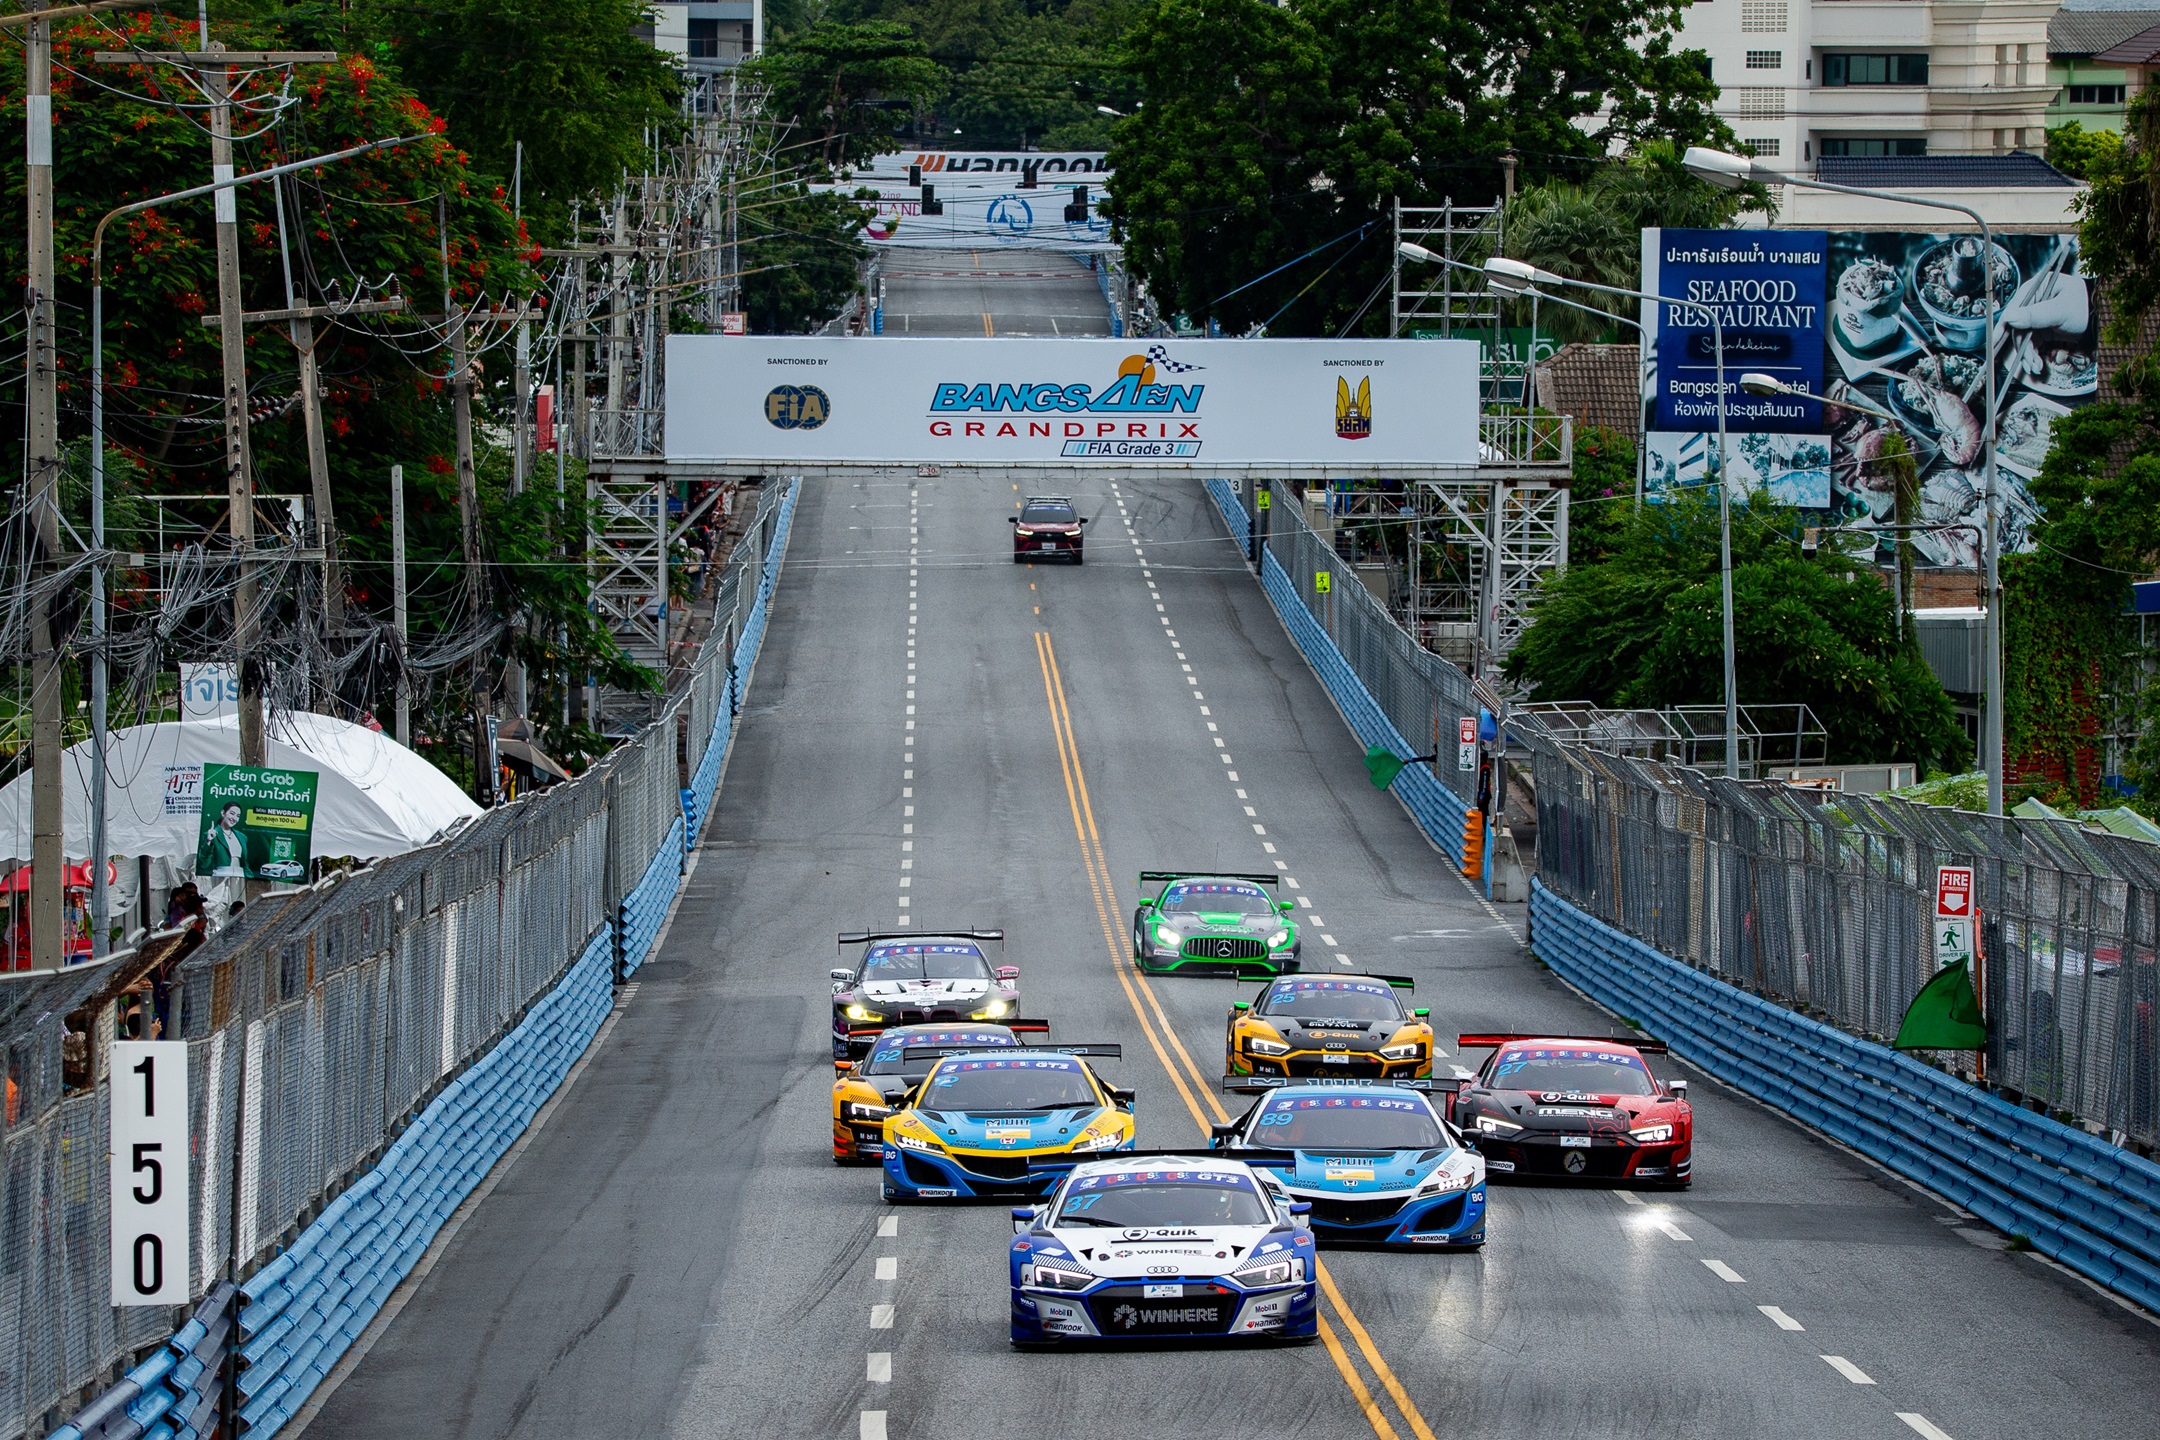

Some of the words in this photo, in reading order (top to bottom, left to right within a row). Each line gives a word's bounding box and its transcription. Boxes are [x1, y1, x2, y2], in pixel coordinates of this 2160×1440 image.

[1769, 250, 1821, 264] บางแสน
[1687, 279, 1797, 304] SEAFOOD
[1667, 304, 1816, 329] RESTAURANT
[930, 374, 1206, 413] BANGSAEN
[1669, 379, 1737, 398] Bangsaen
[1088, 442, 1112, 456] FIA
[1116, 442, 1162, 456] Grade
[1165, 442, 1175, 456] 3
[229, 769, 257, 783] เรียก
[260, 772, 296, 786] Grab
[267, 808, 301, 817] NEWGRAB
[1941, 872, 1969, 887] FIRE
[1270, 993, 1296, 1005] 25
[873, 1050, 902, 1062] 62
[1497, 1061, 1528, 1077] 27
[1259, 1112, 1295, 1127] 89
[1538, 1107, 1614, 1118] MENG
[884, 1150, 897, 1160] BG
[133, 1055, 164, 1296] 150
[1197, 1172, 1240, 1185] GT3
[1064, 1193, 1103, 1213] 37
[1471, 1192, 1484, 1203] BG
[1049, 1307, 1066, 1316] Mobil
[1139, 1306, 1220, 1324] WINHERE
[1254, 1304, 1272, 1314] Mobil
